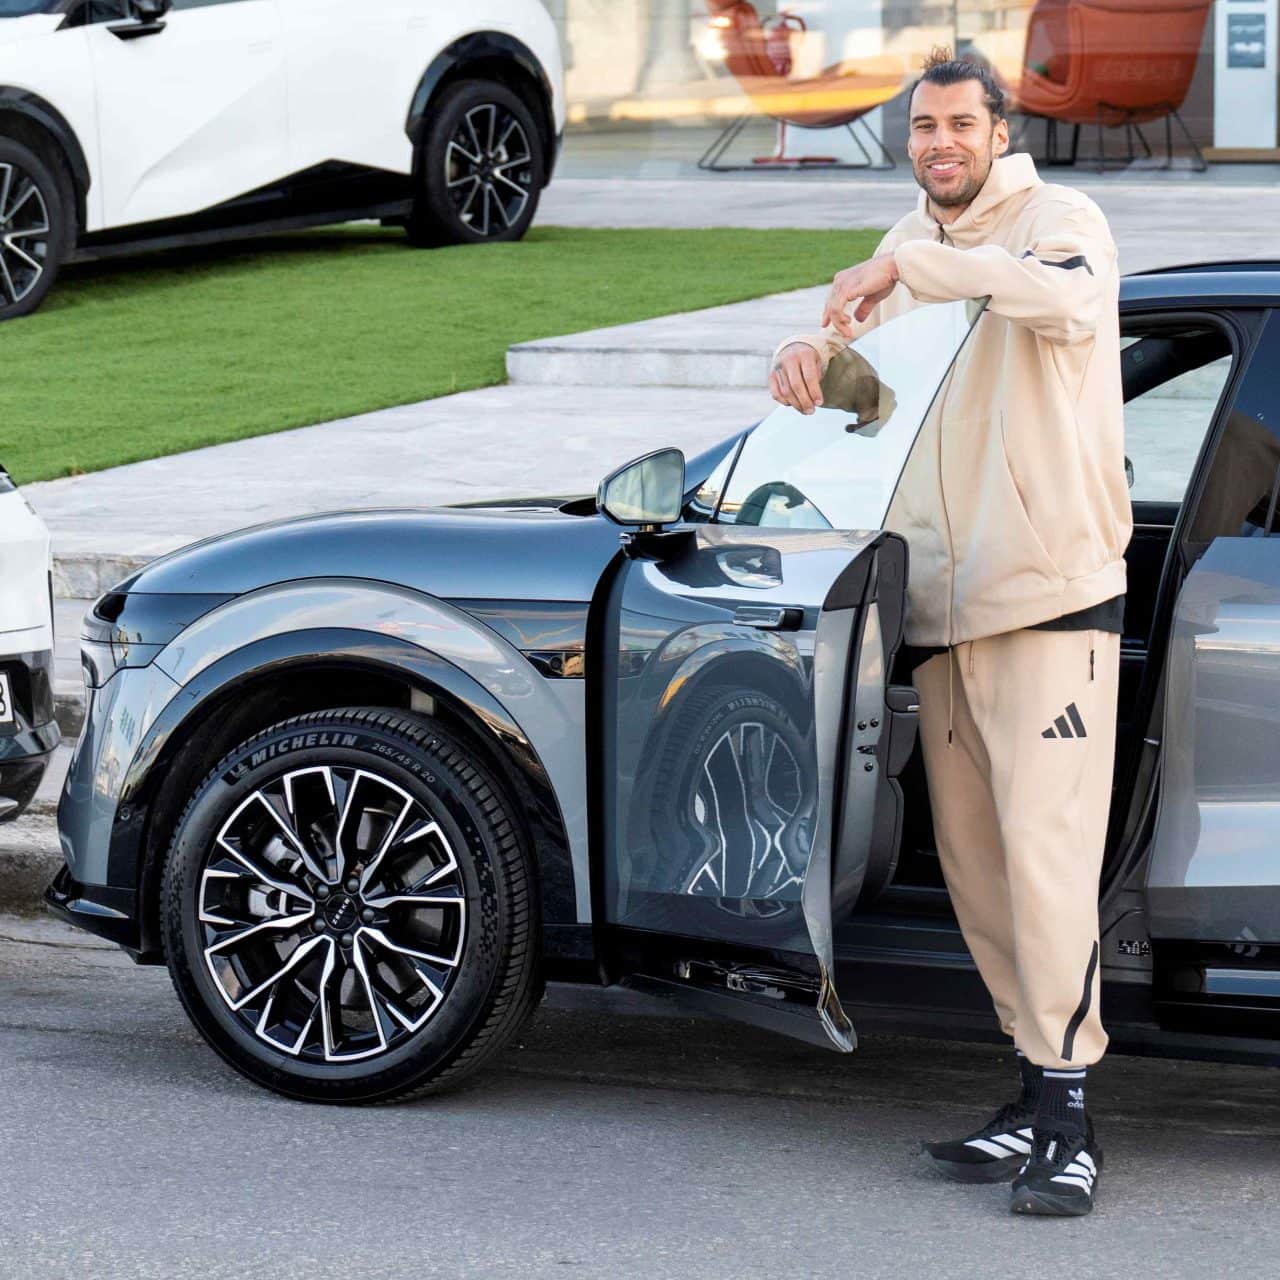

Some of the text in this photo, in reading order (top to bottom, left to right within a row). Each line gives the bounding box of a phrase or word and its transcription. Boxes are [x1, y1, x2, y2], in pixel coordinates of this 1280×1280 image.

[252, 733, 358, 766] MICHELIN
[371, 743, 411, 766] 265/45
[420, 771, 436, 783] 20
[331, 898, 350, 925] ZEEKR
